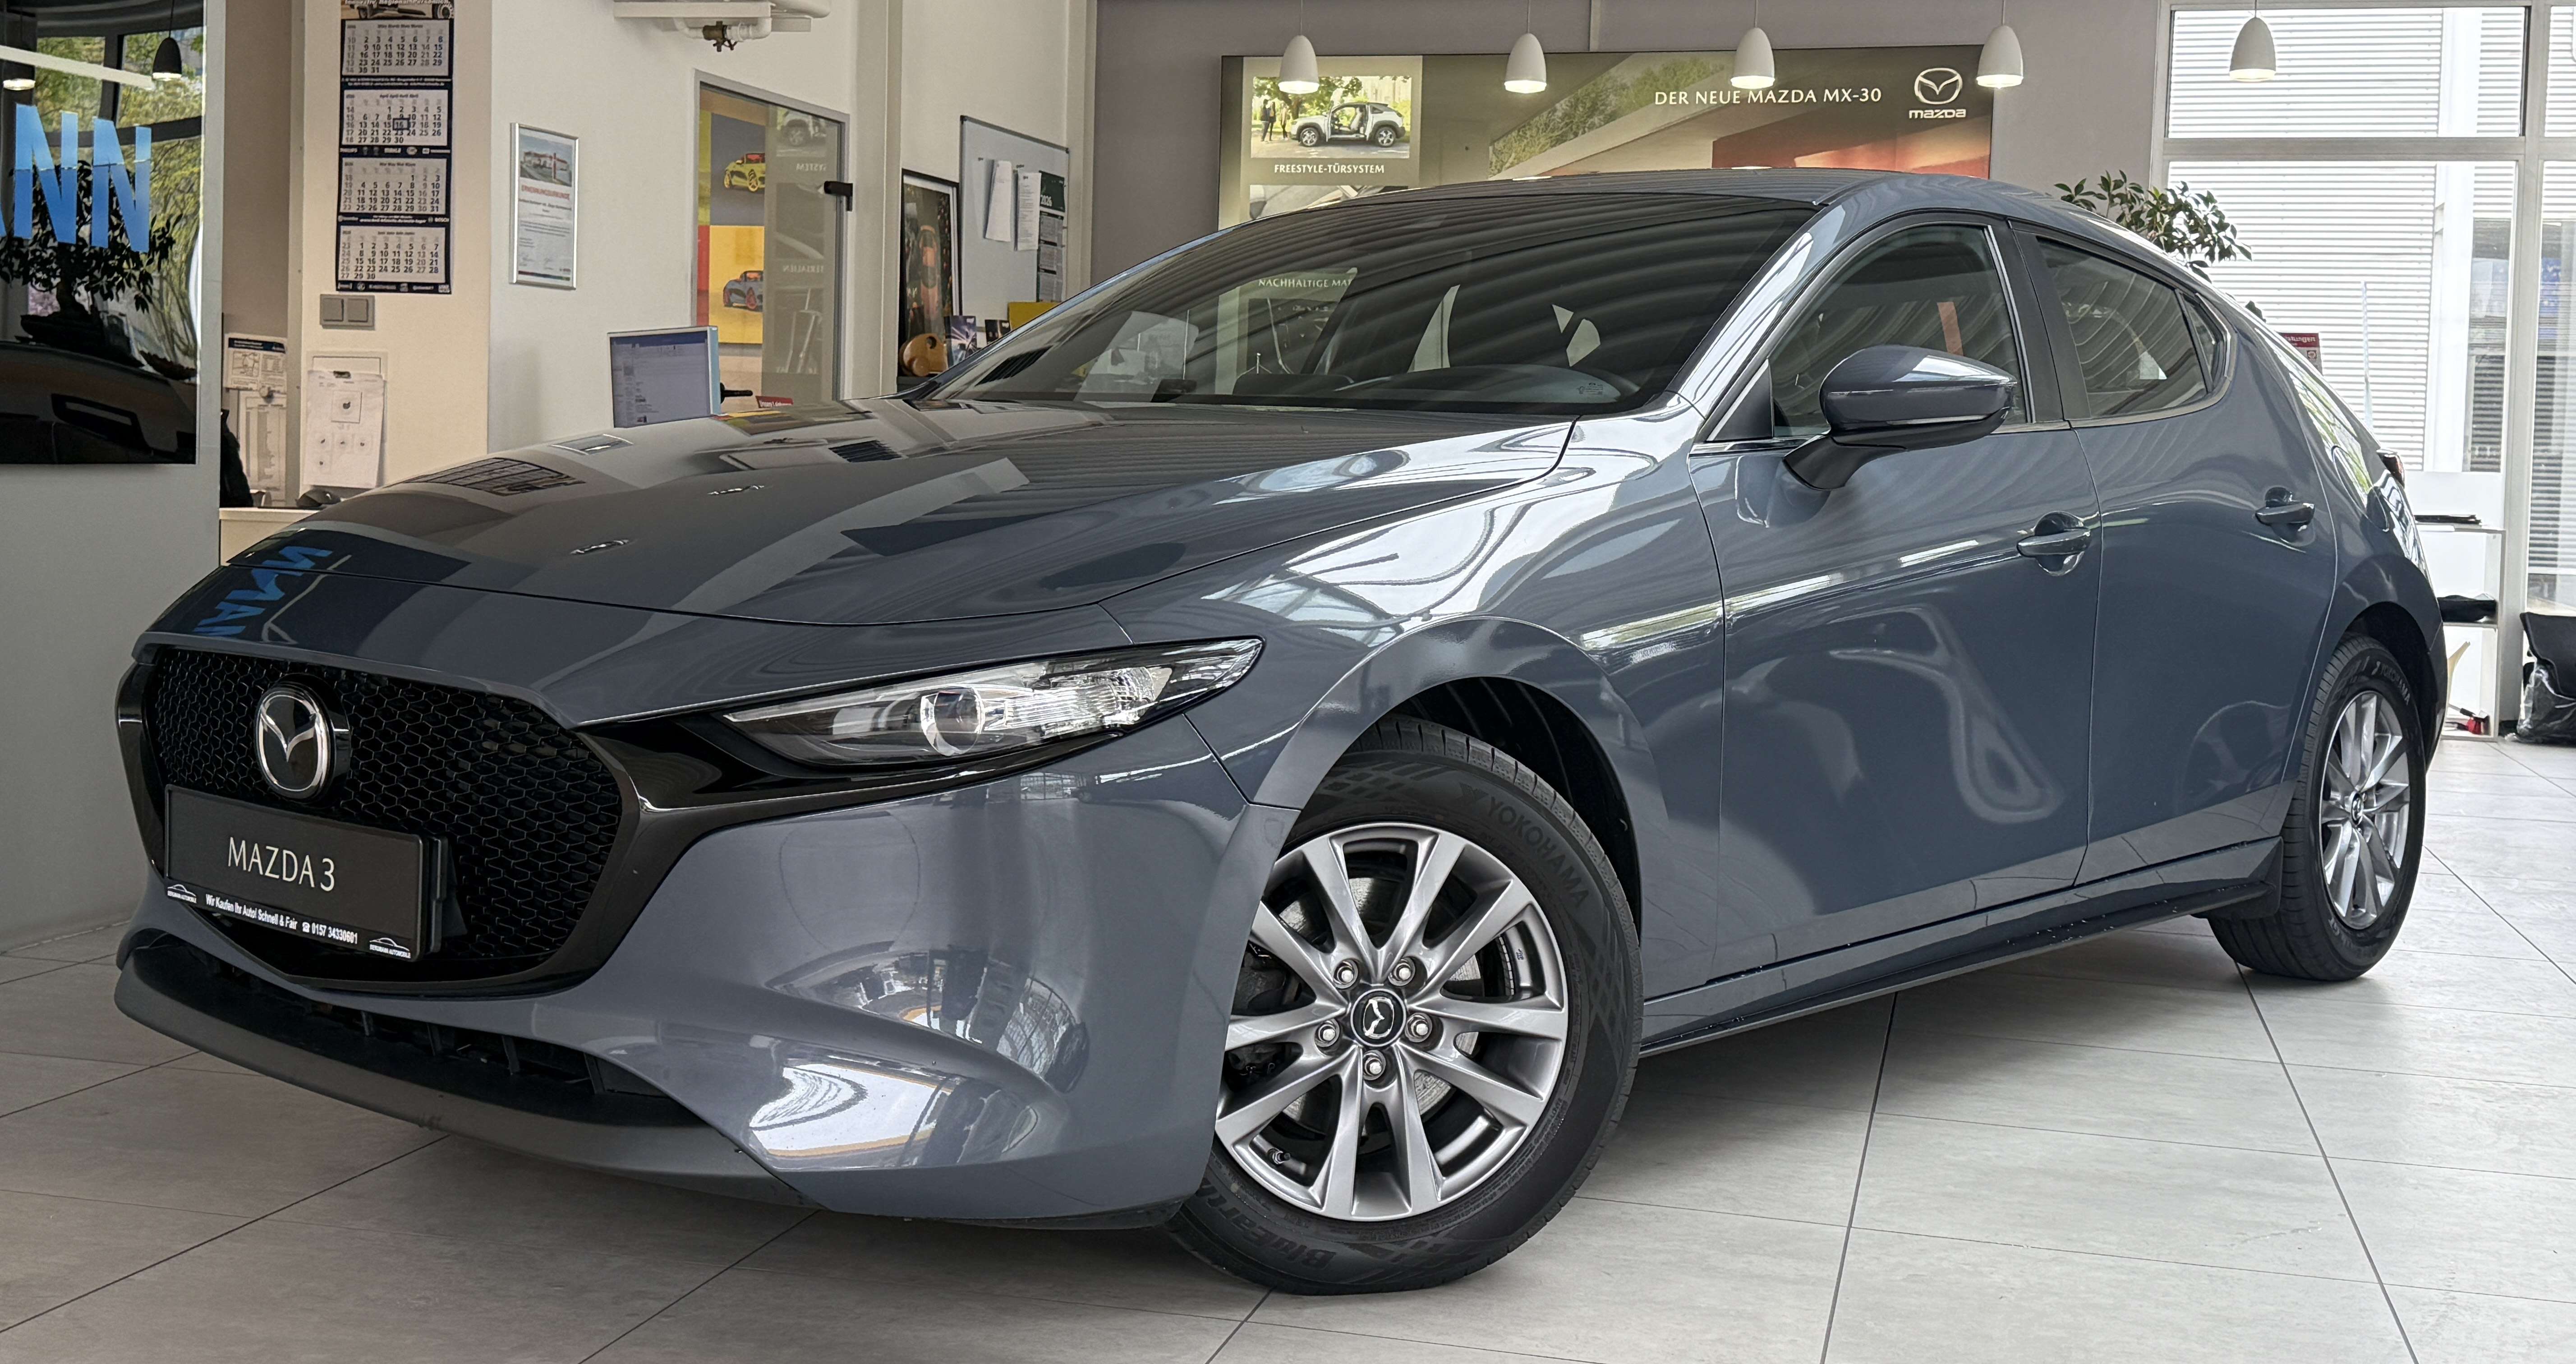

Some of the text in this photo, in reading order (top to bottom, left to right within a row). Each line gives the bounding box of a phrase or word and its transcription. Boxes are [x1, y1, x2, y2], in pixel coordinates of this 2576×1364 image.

[1655, 88, 1881, 105] DER NEUE MAZDA MX-30
[1909, 109, 1966, 119] mazda
[0, 103, 152, 253] NN
[1274, 163, 1385, 174] FREESTYLE-TÜRSYSTEM
[1259, 278, 1329, 287] NACHHALTIGE
[228, 837, 335, 892] MAZDA 3
[1488, 796, 1589, 905] YOKOHAMA
[206, 894, 215, 906] Wir
[216, 897, 234, 912] Kaufen
[258, 909, 278, 925] Schnell
[279, 915, 284, 926] &
[285, 916, 298, 930] Fair
[312, 922, 327, 936] 0157
